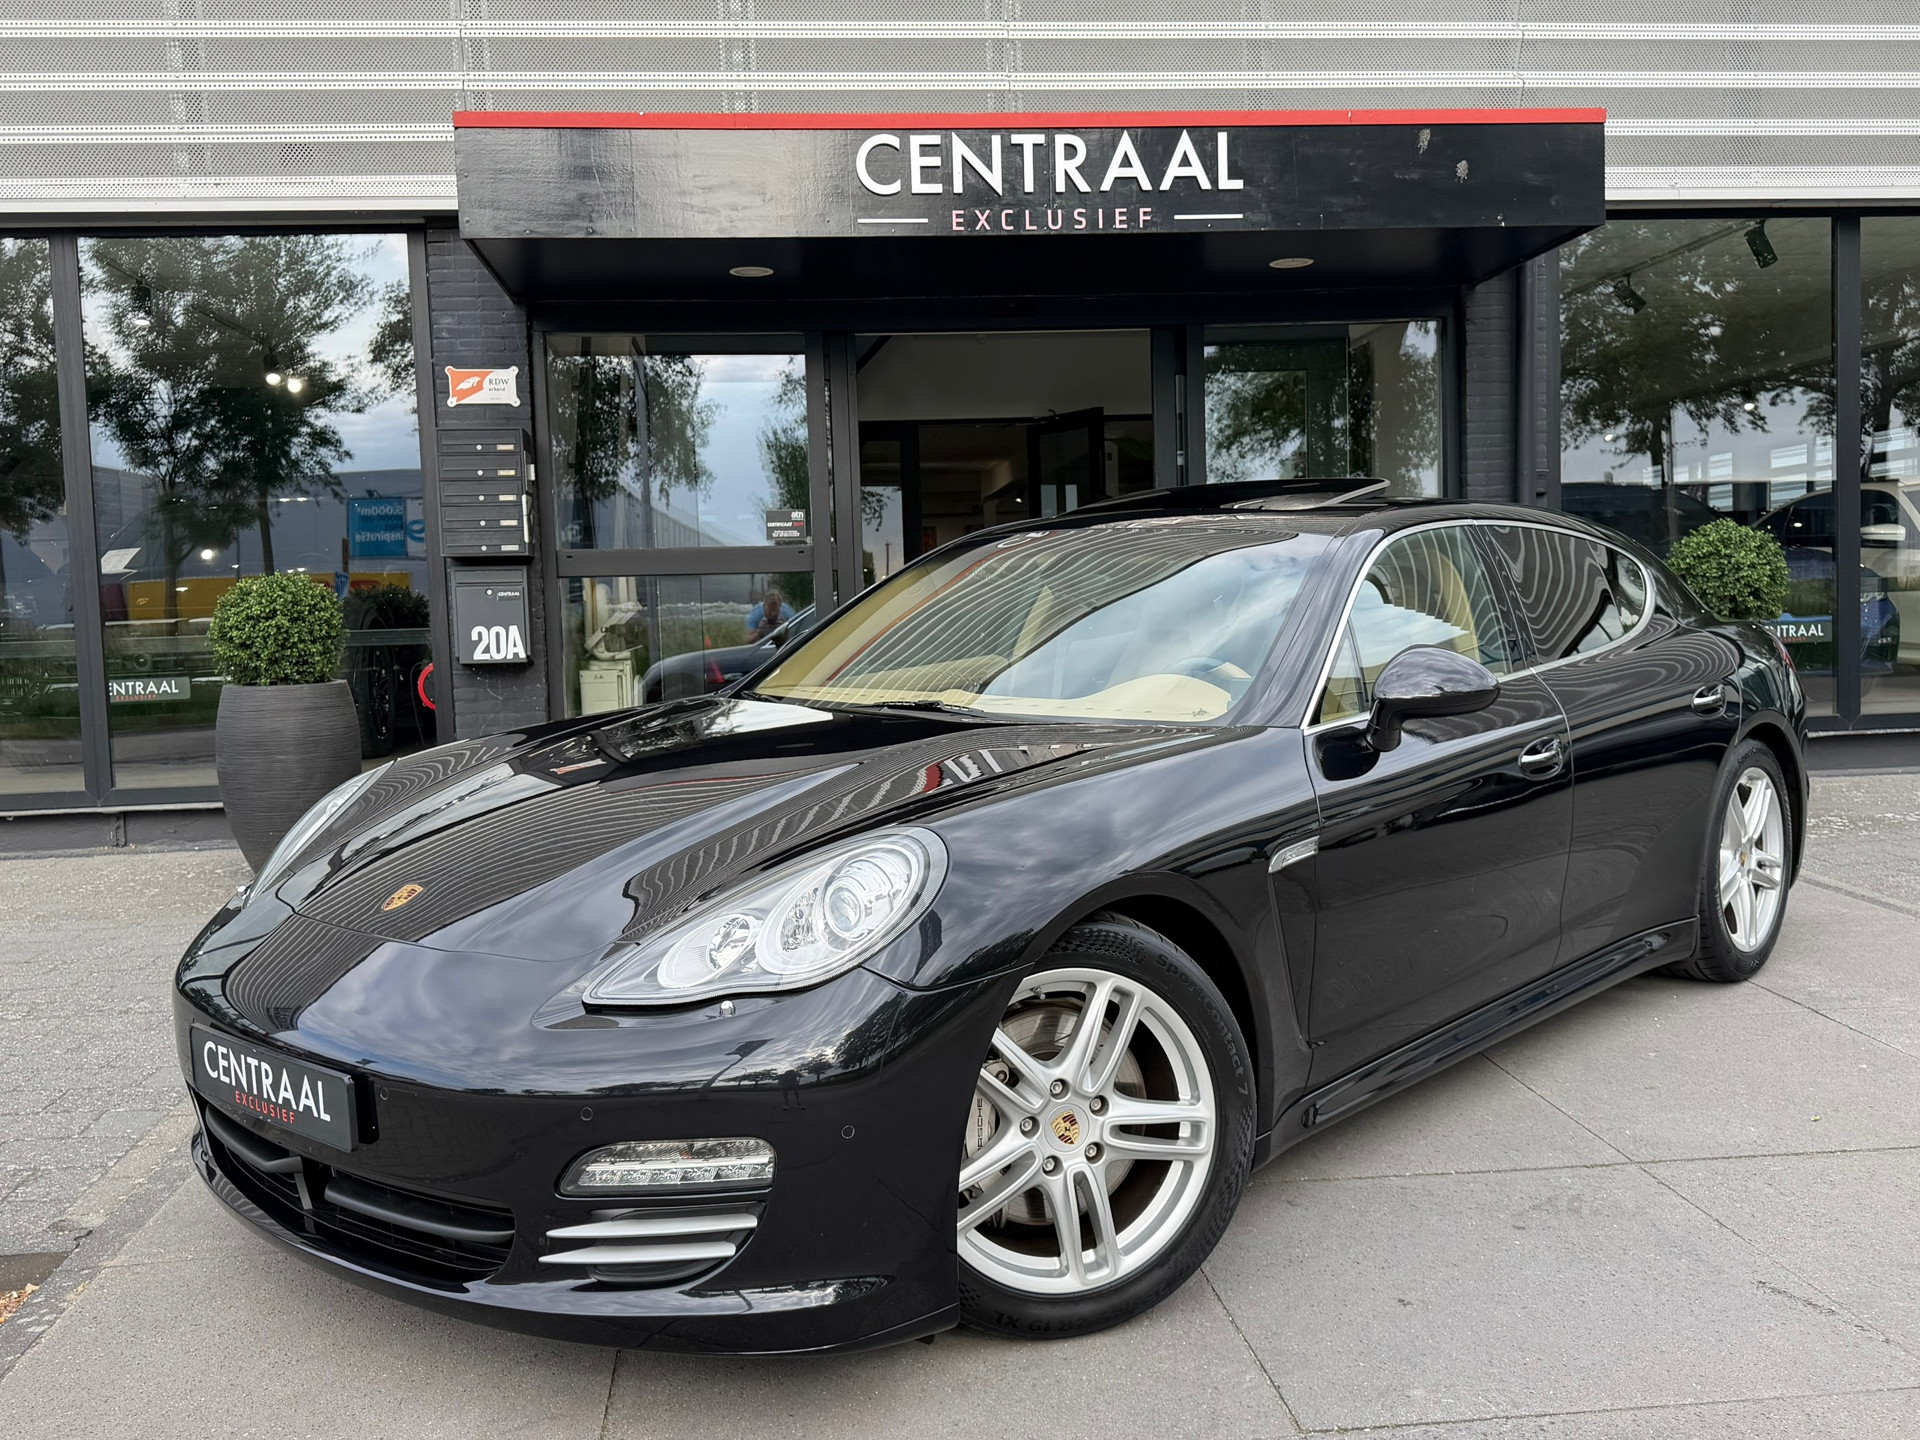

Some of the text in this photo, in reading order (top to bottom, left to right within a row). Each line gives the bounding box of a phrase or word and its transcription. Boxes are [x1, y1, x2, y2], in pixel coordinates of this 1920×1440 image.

[855, 128, 1244, 197] CENTRAAL
[951, 207, 1152, 231] EXCLUSIEF
[488, 378, 509, 386] RDW
[471, 625, 526, 660] 20A
[203, 1040, 331, 1122] CENTRAAL
[235, 1090, 296, 1124] EXCLUSIEF
